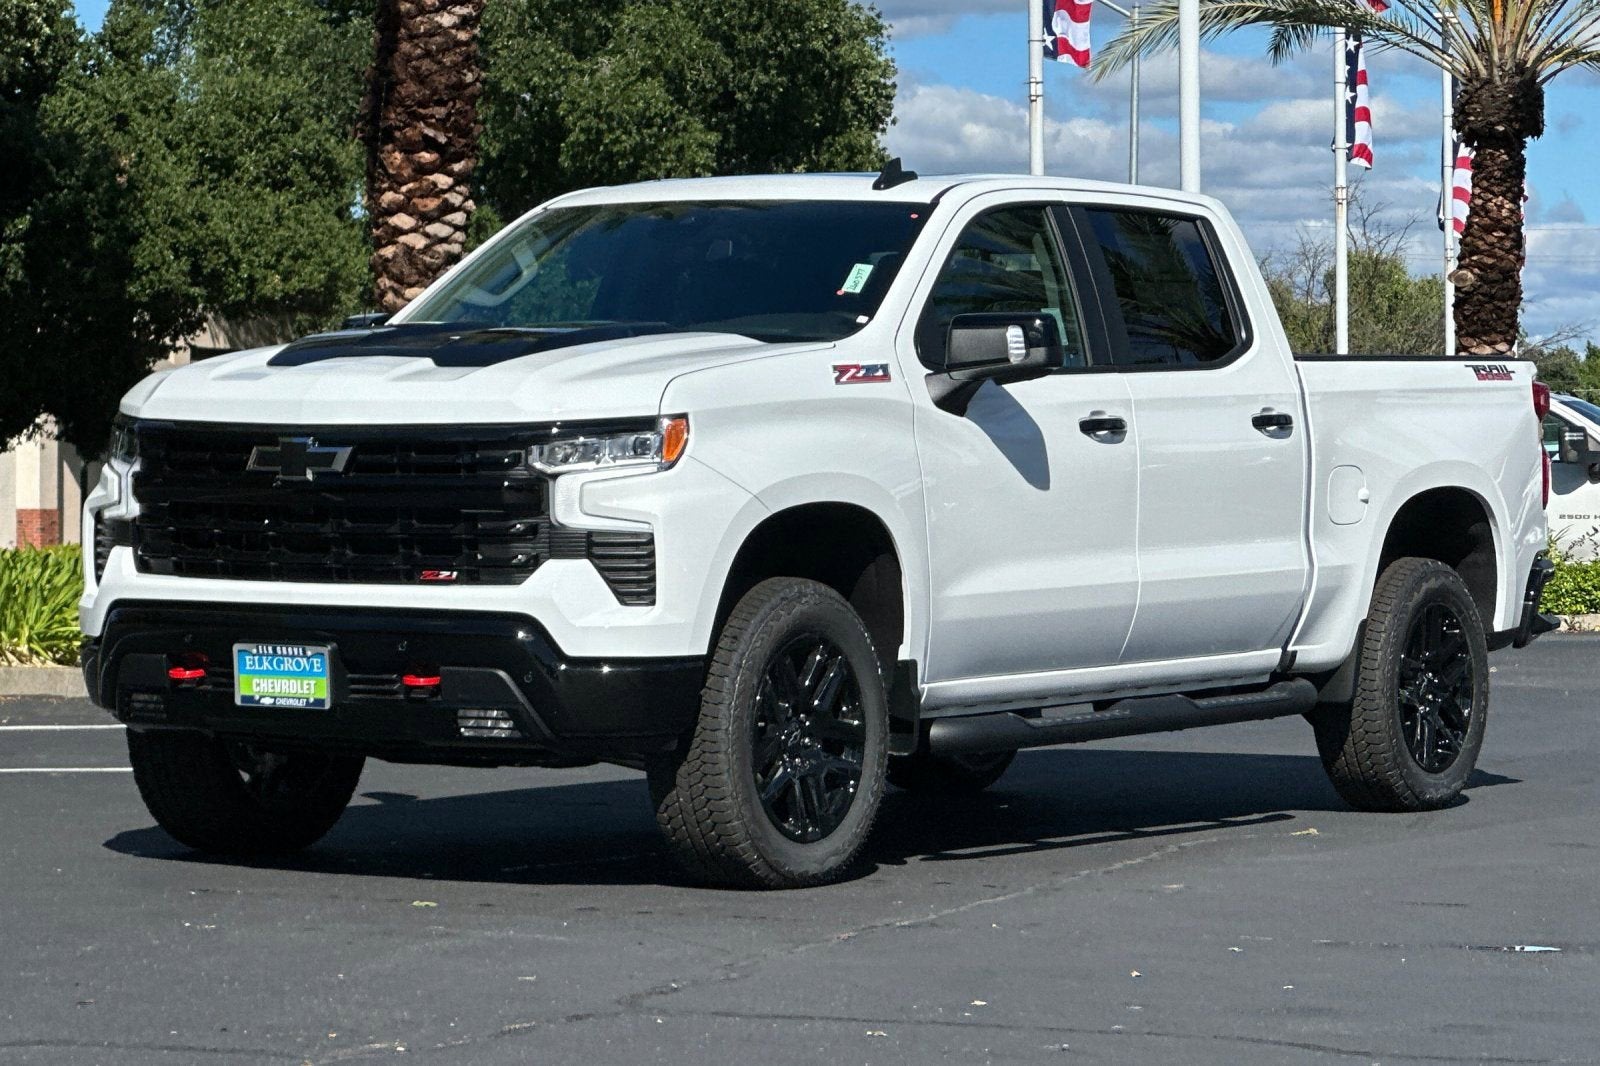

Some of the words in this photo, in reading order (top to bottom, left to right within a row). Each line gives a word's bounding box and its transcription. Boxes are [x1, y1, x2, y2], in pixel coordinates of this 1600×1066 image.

[1464, 364, 1516, 374] TRAIL
[420, 570, 458, 580] Z71
[258, 645, 273, 655] ELK
[276, 646, 303, 656] GROVE
[245, 655, 273, 671] ELK
[272, 656, 323, 673] GROVE
[252, 678, 317, 695] CHEVROLET
[275, 698, 307, 707] CHEVROLET
